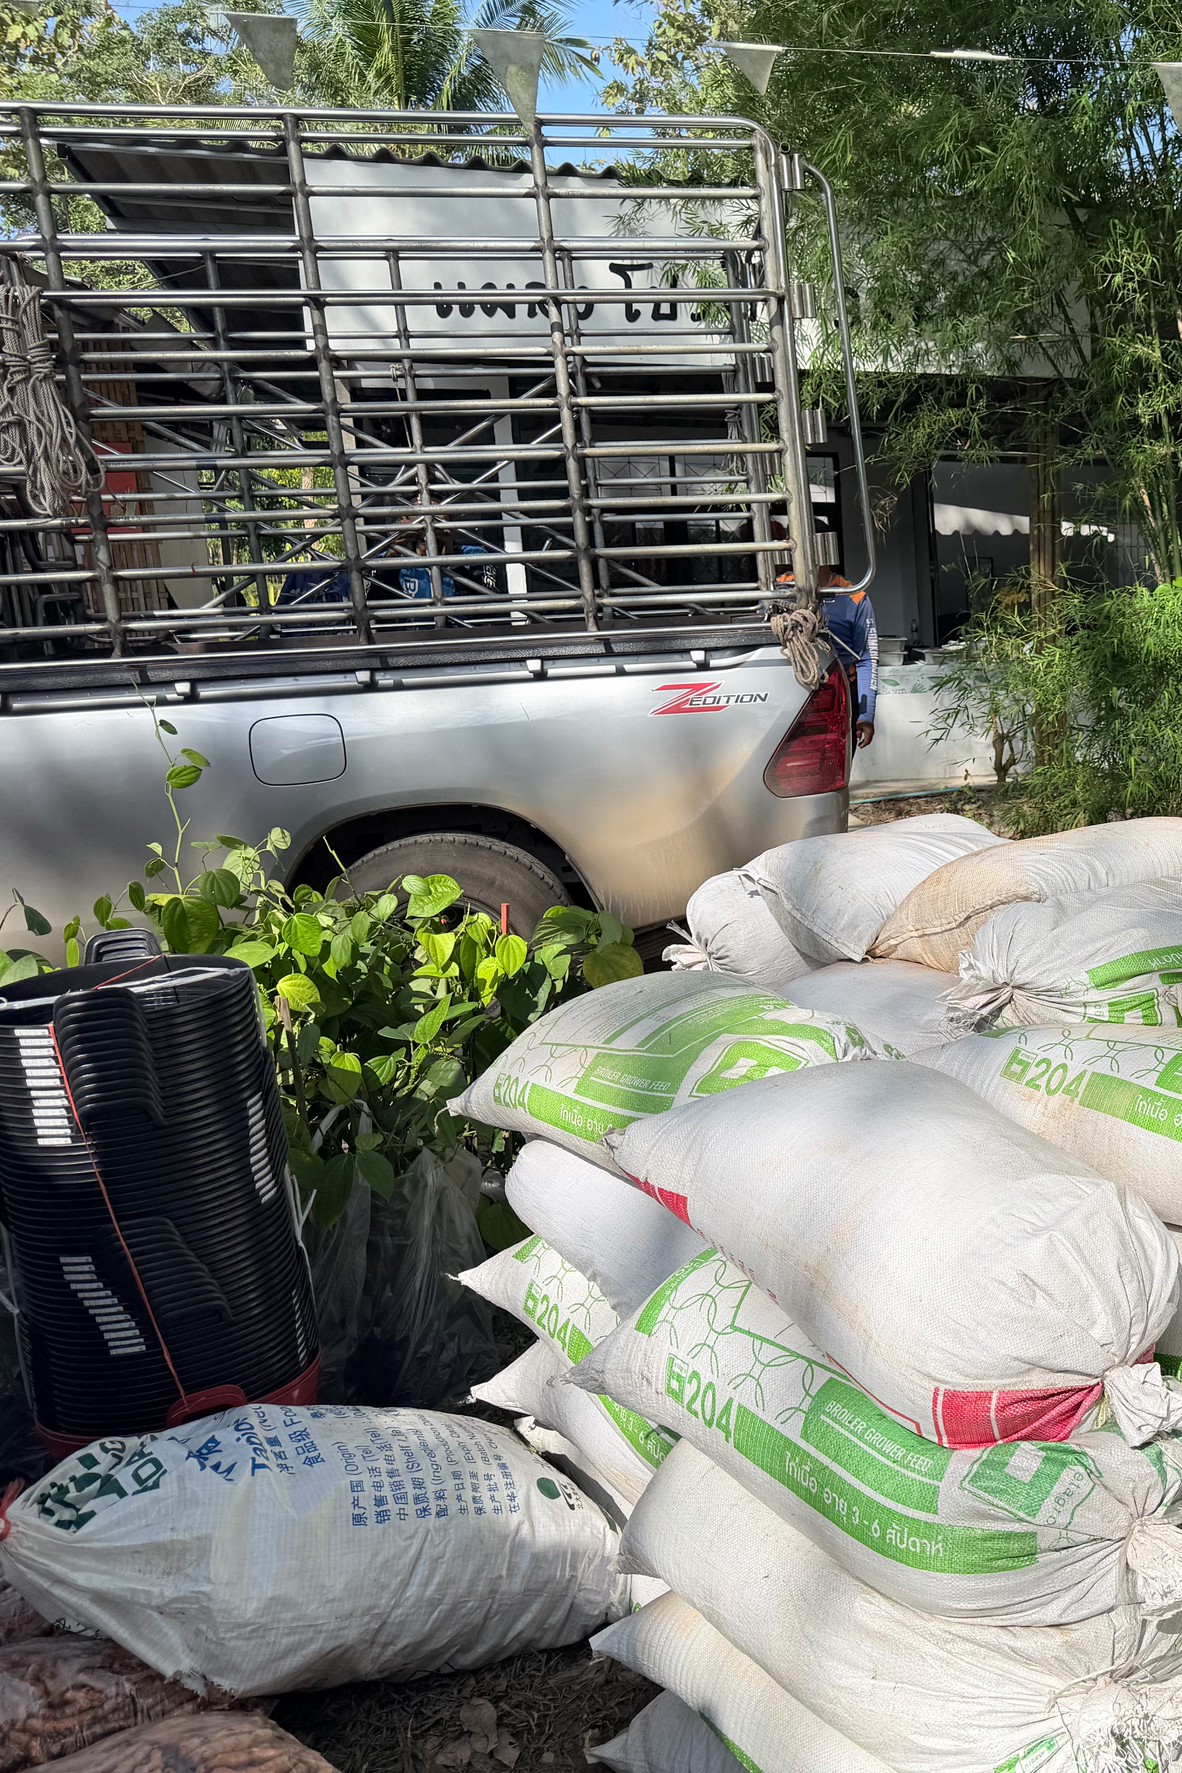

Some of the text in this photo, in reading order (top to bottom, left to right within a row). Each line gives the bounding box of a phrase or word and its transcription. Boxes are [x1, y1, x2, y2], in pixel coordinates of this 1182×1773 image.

[688, 693, 769, 706] EDITION
[503, 1074, 529, 1114] 204
[594, 1067, 671, 1091] BROILER GROWER FEED
[1025, 1056, 1087, 1100] 204
[1135, 1094, 1168, 1121] ไก่เนื้อ
[536, 1294, 571, 1352] 204
[685, 1370, 734, 1444] 204
[288, 1427, 326, 1468] 食品级
[331, 1441, 363, 1476] (Origin)
[354, 1445, 380, 1461] (Tel)
[398, 1444, 423, 1473] (Shelf
[457, 1440, 477, 1464] (Expiry
[824, 1400, 934, 1473] BROILER GROWER FEED
[350, 1480, 369, 1527] 原产国
[366, 1465, 392, 1525] 销售电话
[411, 1477, 433, 1519] 保质期
[432, 1488, 450, 1519] 配料
[451, 1470, 470, 1515] 生产日期
[469, 1470, 487, 1516] 保质期至
[484, 1472, 503, 1516] 生产批号
[493, 1453, 521, 1515] 在华注册编号
[784, 1451, 818, 1494] ไก่เนื้อ
[822, 1488, 848, 1523] อายุ
[852, 1507, 860, 1525] 3
[871, 1520, 880, 1539] 6
[886, 1523, 944, 1557] สัปดาห์
[1045, 1471, 1085, 1526] etagro
